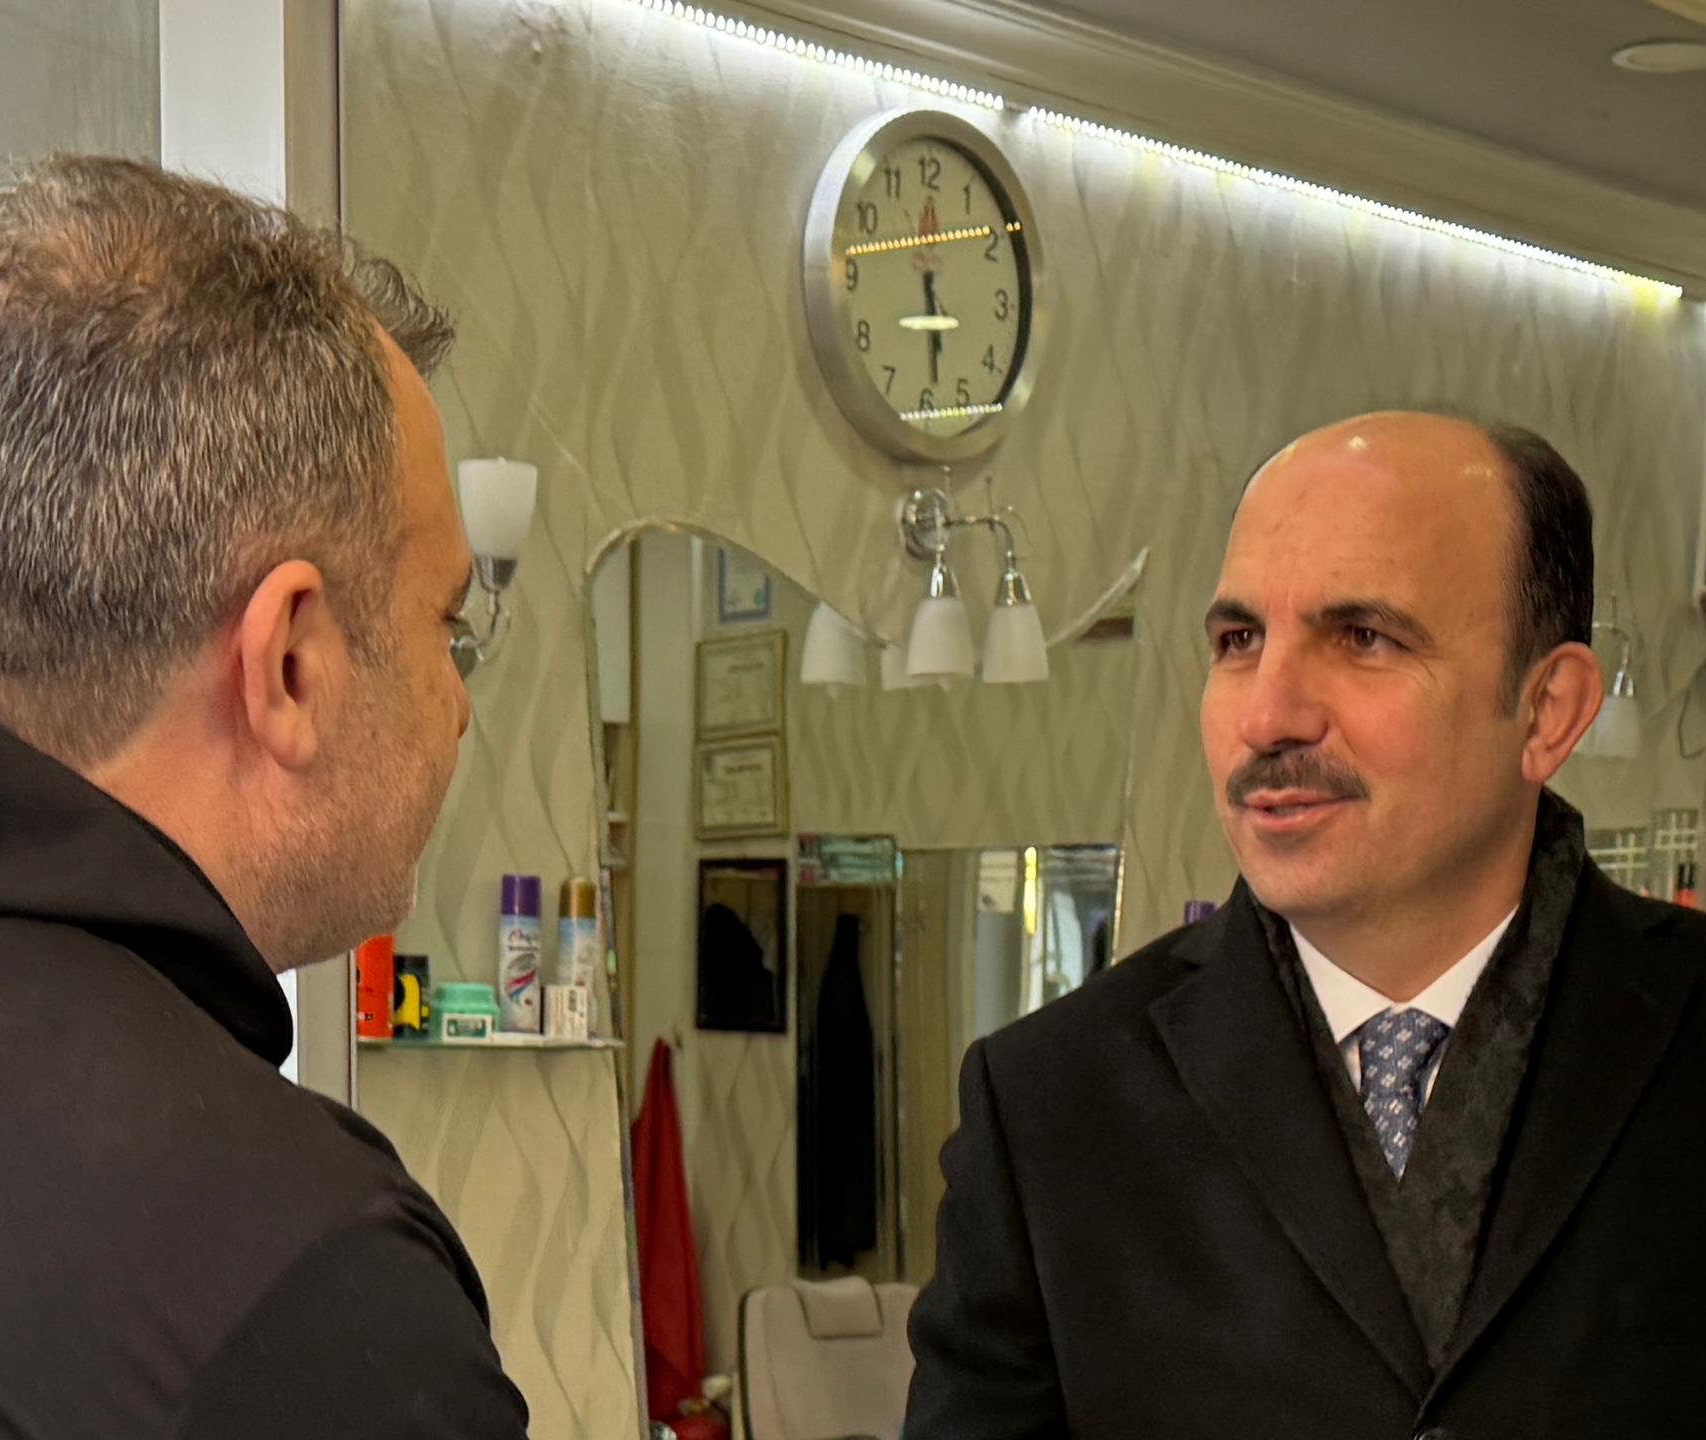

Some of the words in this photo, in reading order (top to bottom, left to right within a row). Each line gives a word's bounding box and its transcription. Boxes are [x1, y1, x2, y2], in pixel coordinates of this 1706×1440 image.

[883, 165, 902, 201] 11
[917, 156, 942, 192] 12
[961, 183, 972, 215] 1
[857, 201, 879, 236] 10
[984, 225, 999, 263] 2
[845, 259, 860, 293] 9
[994, 287, 1010, 322] 3
[855, 319, 872, 353] 8
[981, 343, 996, 378] 4
[881, 363, 897, 396] 7
[955, 377, 972, 408] 5
